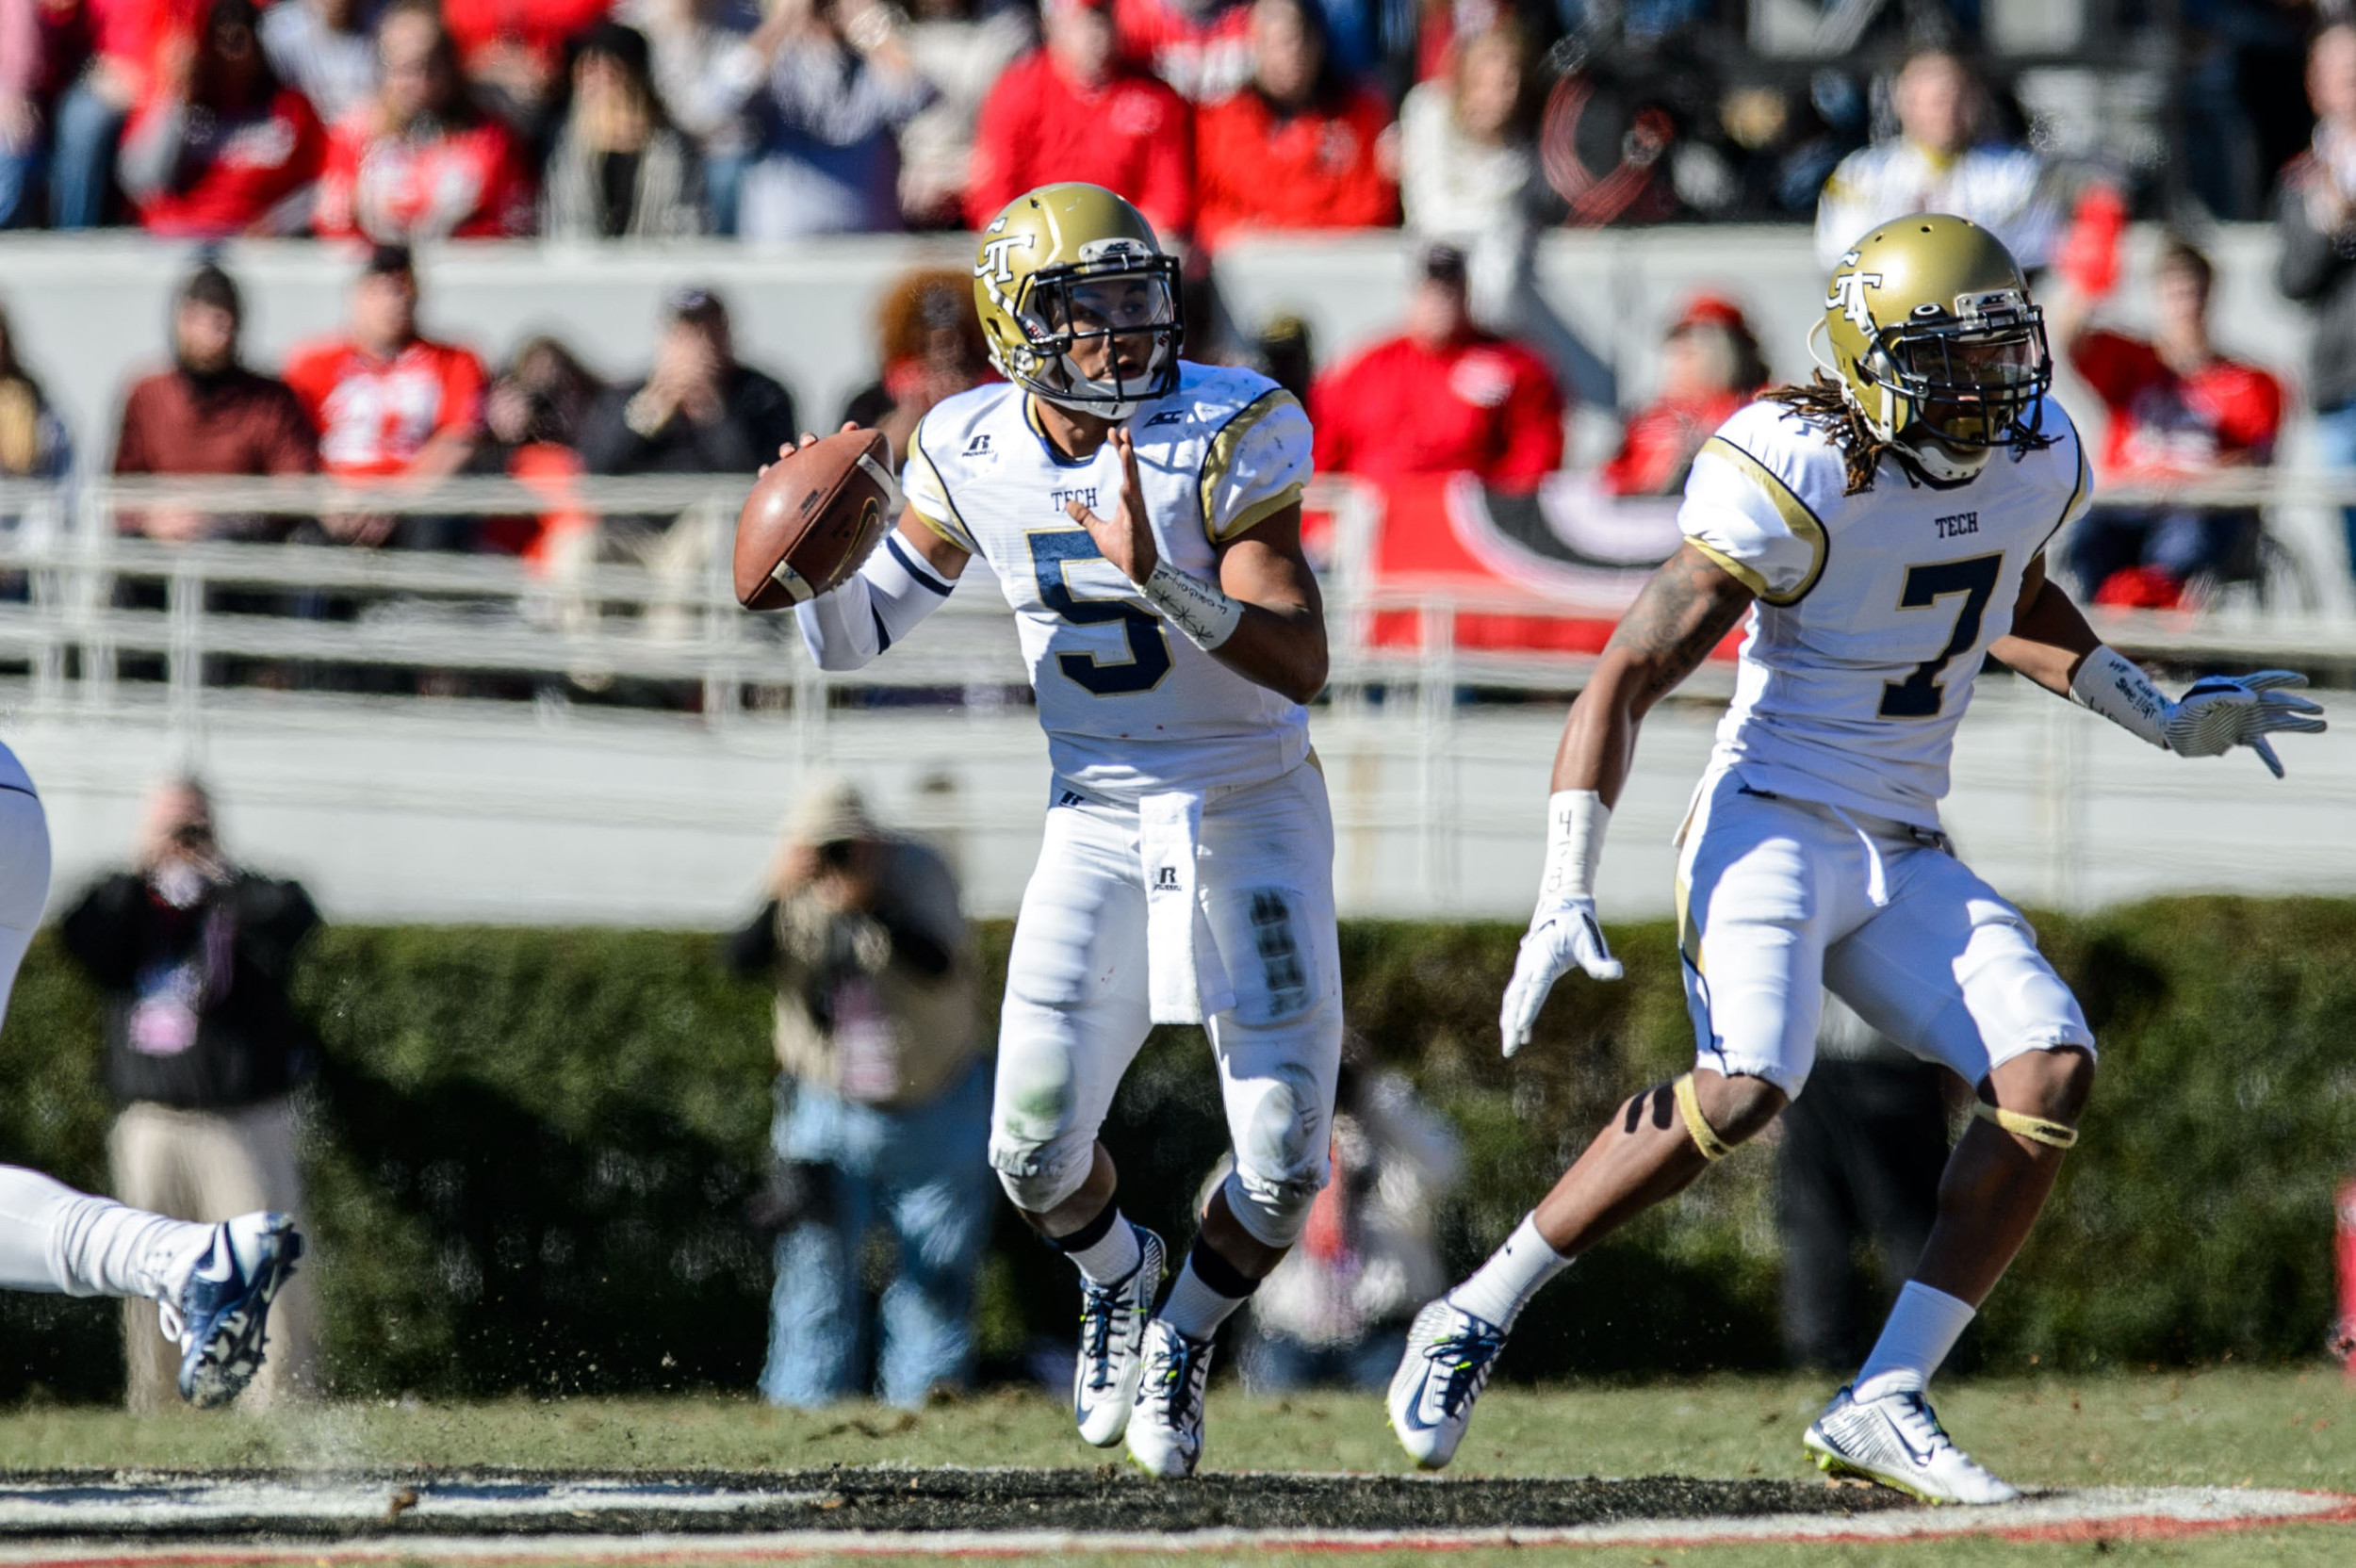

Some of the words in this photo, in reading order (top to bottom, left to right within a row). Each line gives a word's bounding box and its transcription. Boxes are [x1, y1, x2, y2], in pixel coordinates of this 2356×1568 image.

[1142, 410, 1184, 428] ACC
[1935, 512, 1979, 539] TECH
[1023, 525, 1175, 698] 5
[1876, 549, 2006, 721] 7
